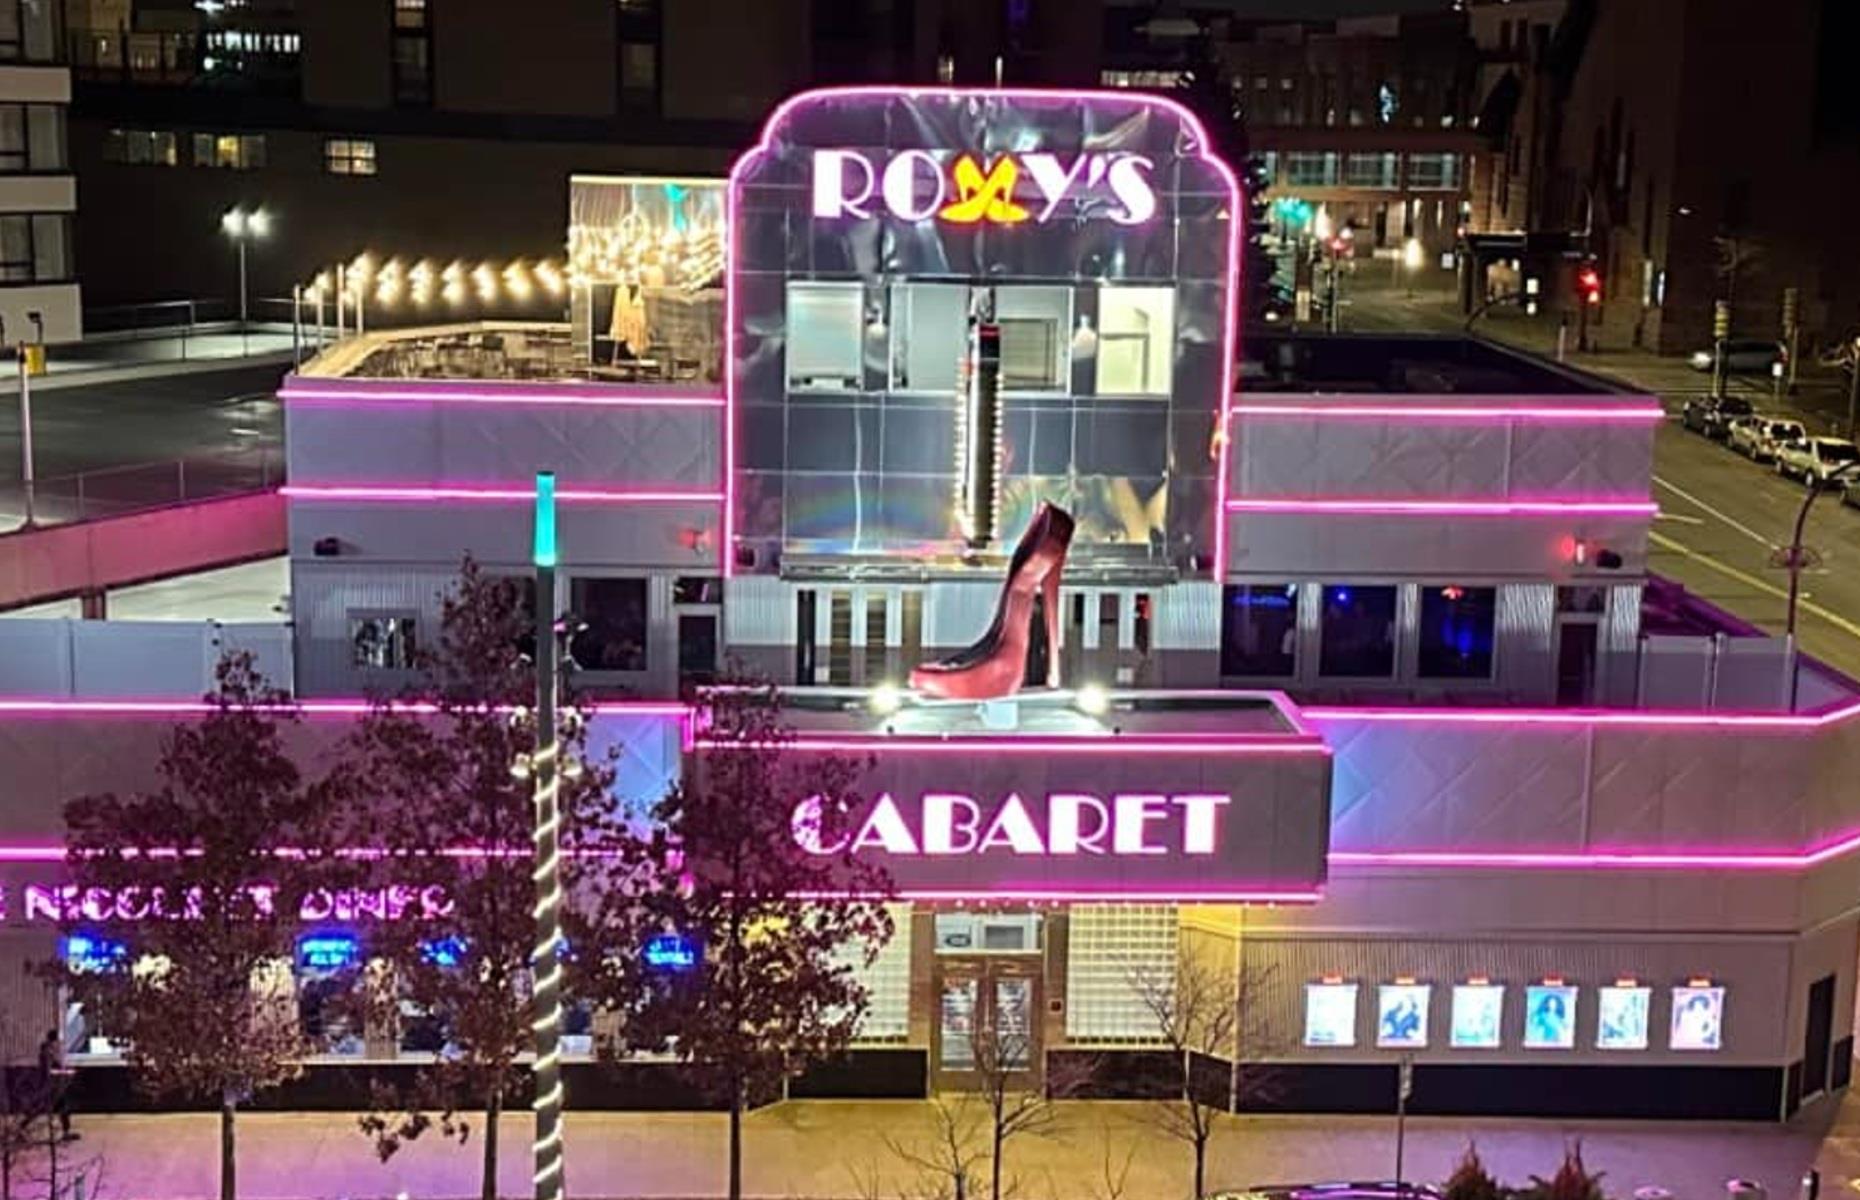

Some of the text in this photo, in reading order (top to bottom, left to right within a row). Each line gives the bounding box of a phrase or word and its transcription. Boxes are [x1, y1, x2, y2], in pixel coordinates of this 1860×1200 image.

[813, 149, 1155, 224] ROXY'S
[791, 792, 1231, 854] CABARET
[25, 885, 280, 920] NICOLLT
